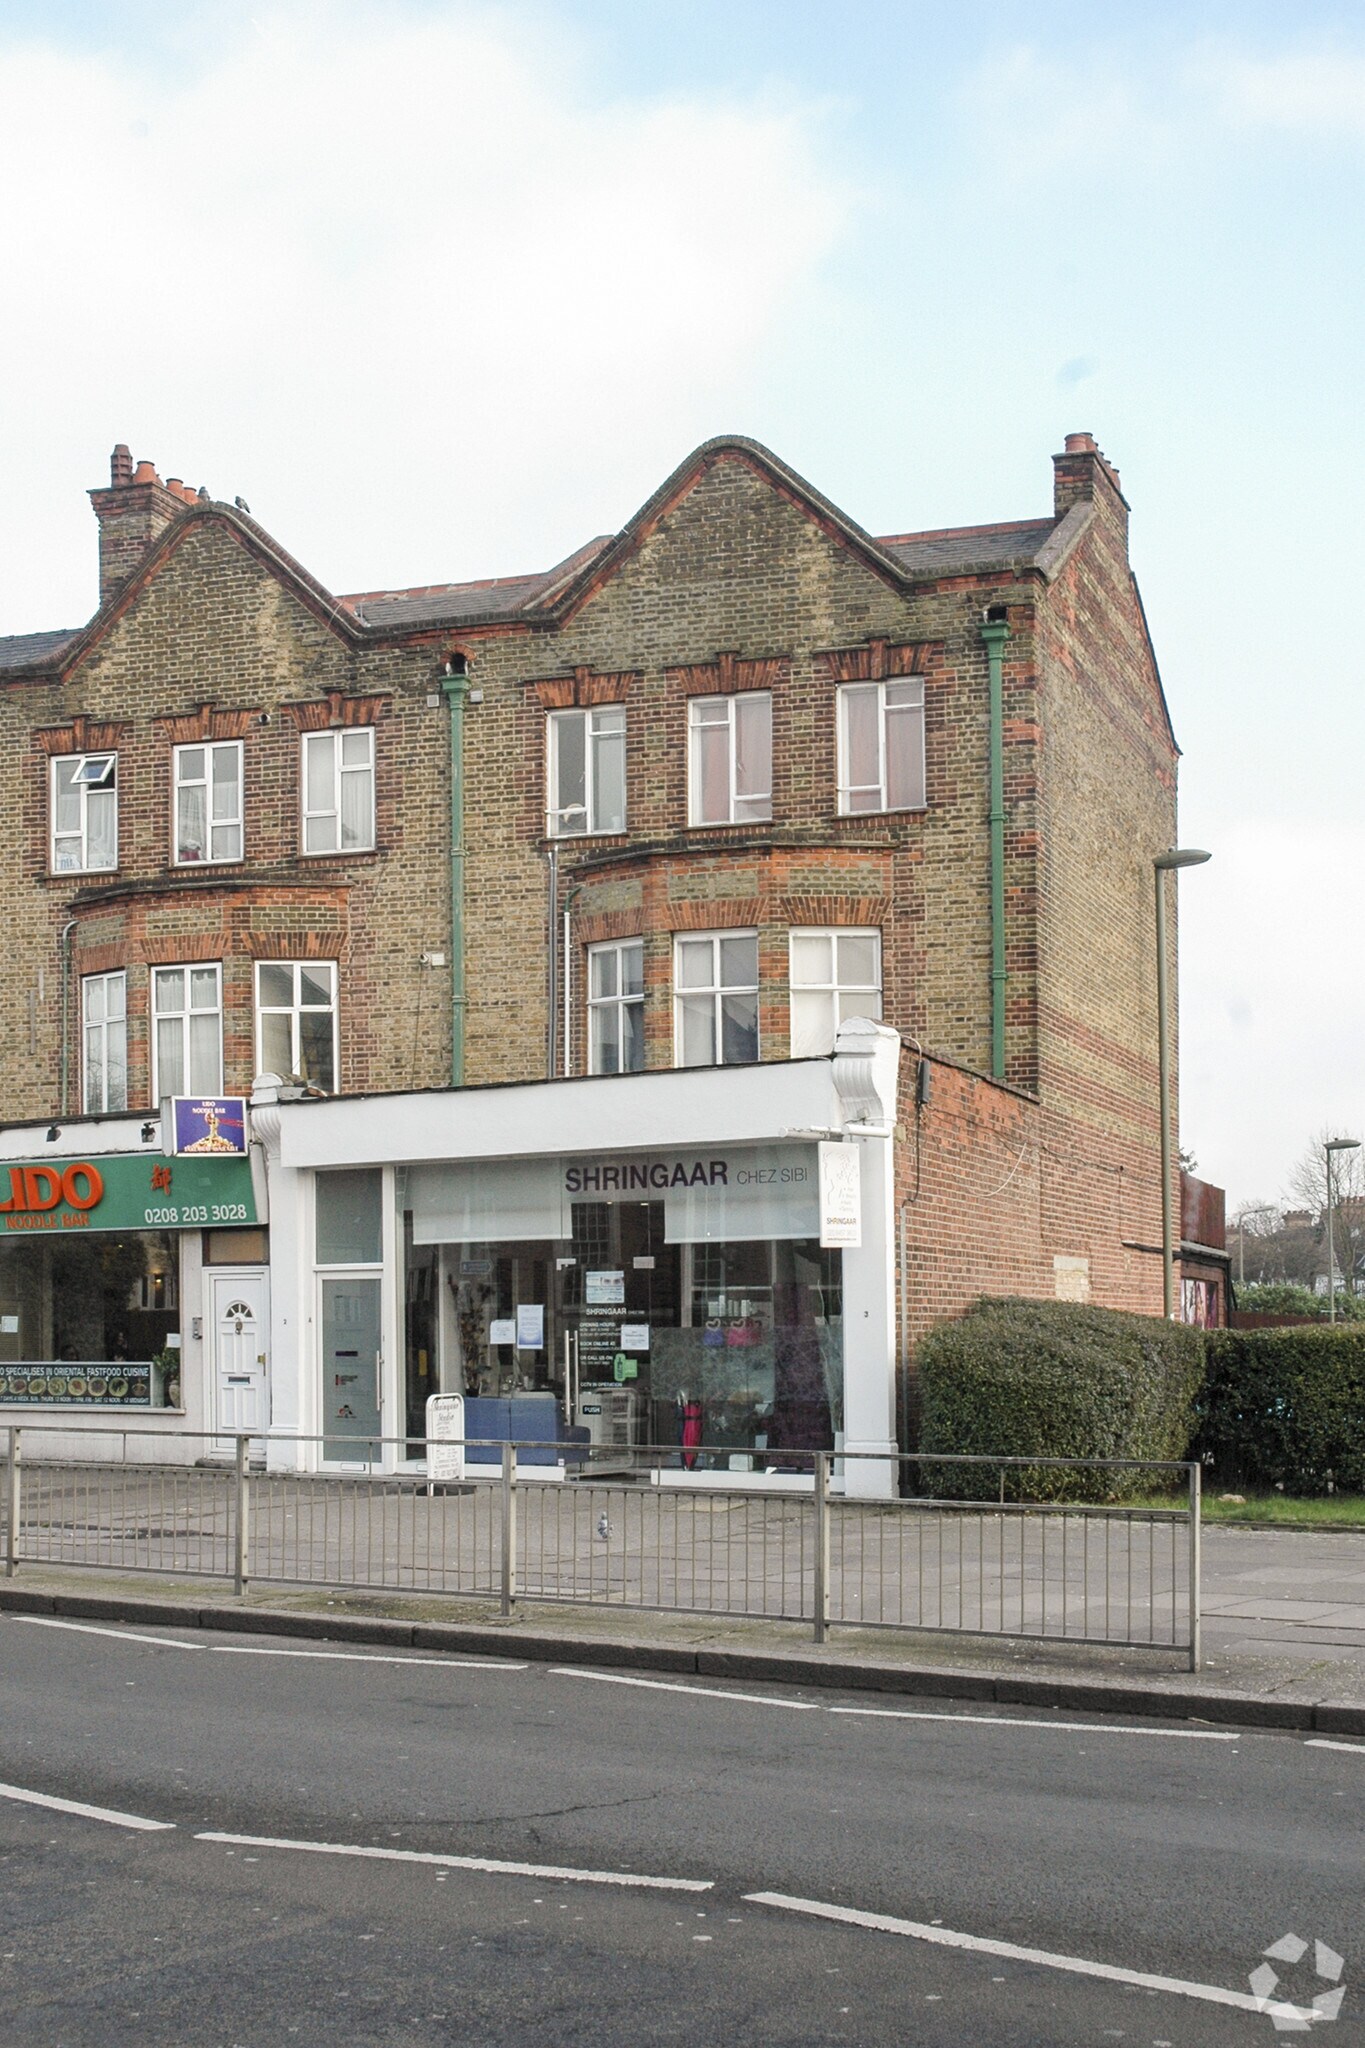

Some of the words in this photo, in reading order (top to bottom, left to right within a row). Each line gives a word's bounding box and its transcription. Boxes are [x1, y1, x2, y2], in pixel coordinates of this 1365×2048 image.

[565, 1160, 728, 1193] SHRINGAAR
[736, 1169, 777, 1185] CHEZ
[780, 1167, 808, 1183] SIBI
[144, 1207, 179, 1224] 0208
[181, 1205, 208, 1222] 203
[211, 1203, 247, 1220] 3028
[6, 1214, 58, 1229] NOODLE
[61, 1212, 90, 1228] BAR
[826, 1217, 857, 1225] SHRINGAAR
[585, 1307, 627, 1316] SHRINGAAR
[6, 1367, 45, 1375] SPECIALISES
[46, 1367, 52, 1375] IN
[54, 1367, 85, 1376] ORIENTAL
[87, 1367, 121, 1376] FASTFOOD
[123, 1367, 149, 1376] CUISINE
